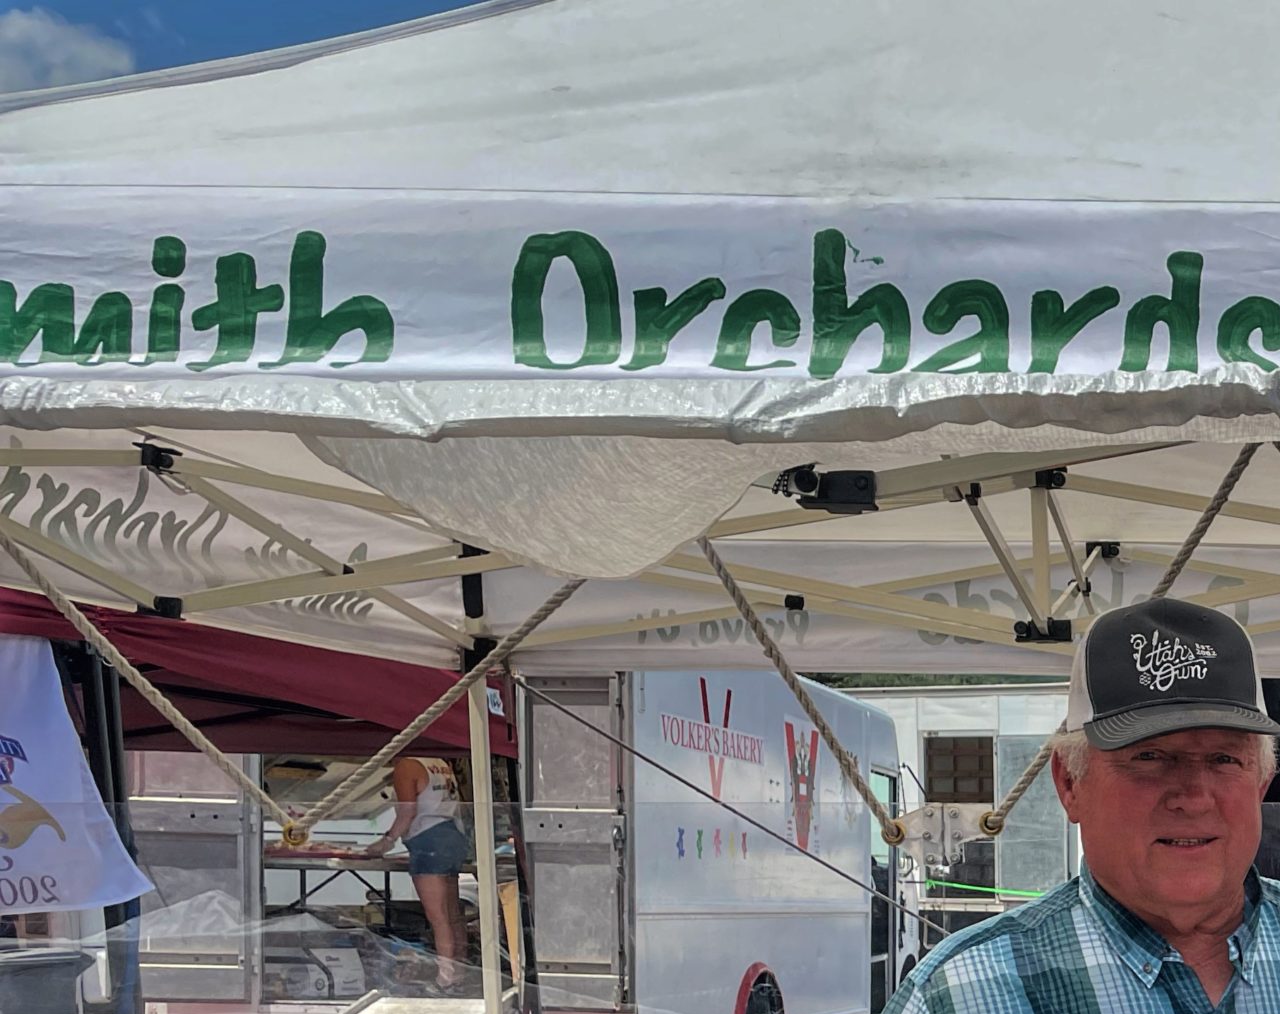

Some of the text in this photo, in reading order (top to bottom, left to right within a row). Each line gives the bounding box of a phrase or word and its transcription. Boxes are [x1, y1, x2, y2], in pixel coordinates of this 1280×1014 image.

[1130, 629, 1196, 675] Utah's
[1149, 658, 1208, 692] Own
[661, 714, 765, 766] VOLKER'S BAKERY
